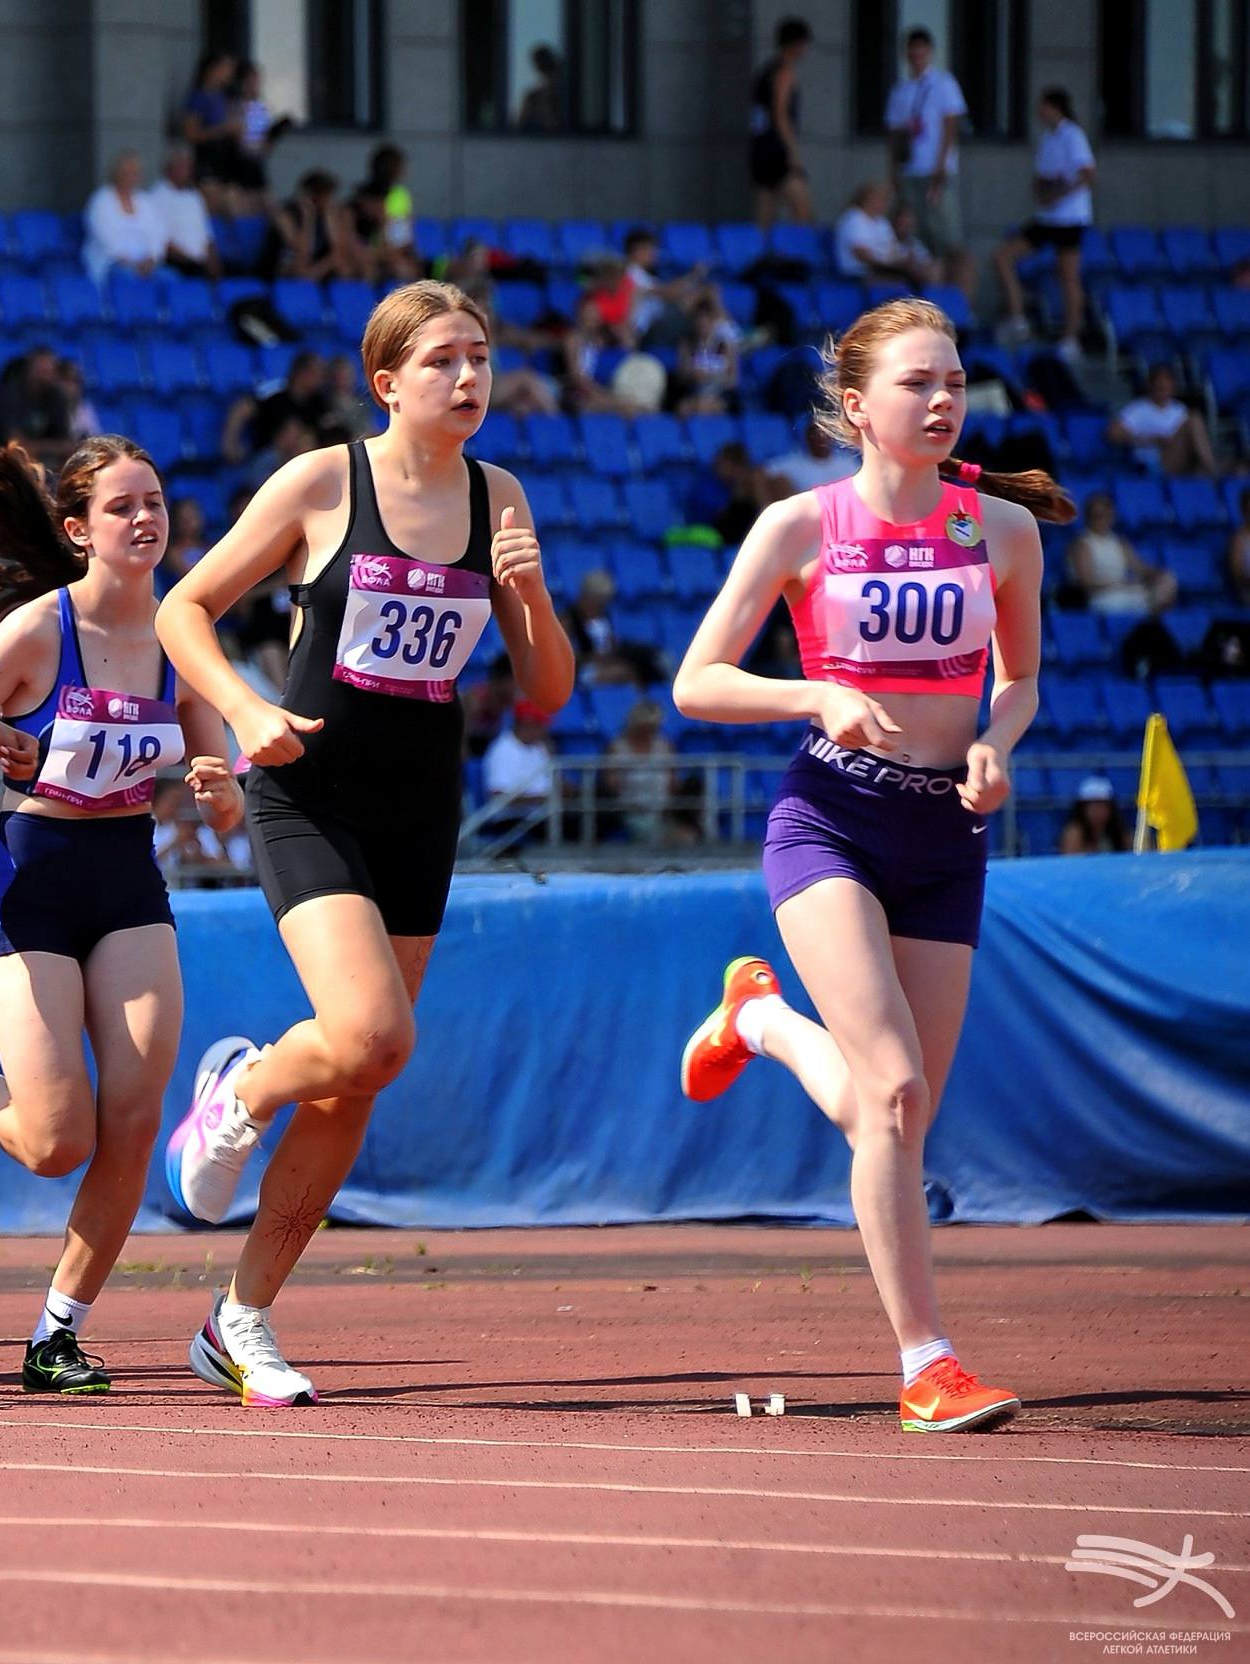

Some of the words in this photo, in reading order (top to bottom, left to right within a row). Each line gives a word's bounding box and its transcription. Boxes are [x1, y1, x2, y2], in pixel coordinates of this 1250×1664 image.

[371, 600, 462, 668] 336
[859, 579, 964, 645] 300
[86, 730, 161, 782] 118
[800, 732, 877, 778] NIKE
[873, 767, 953, 795] PRO
